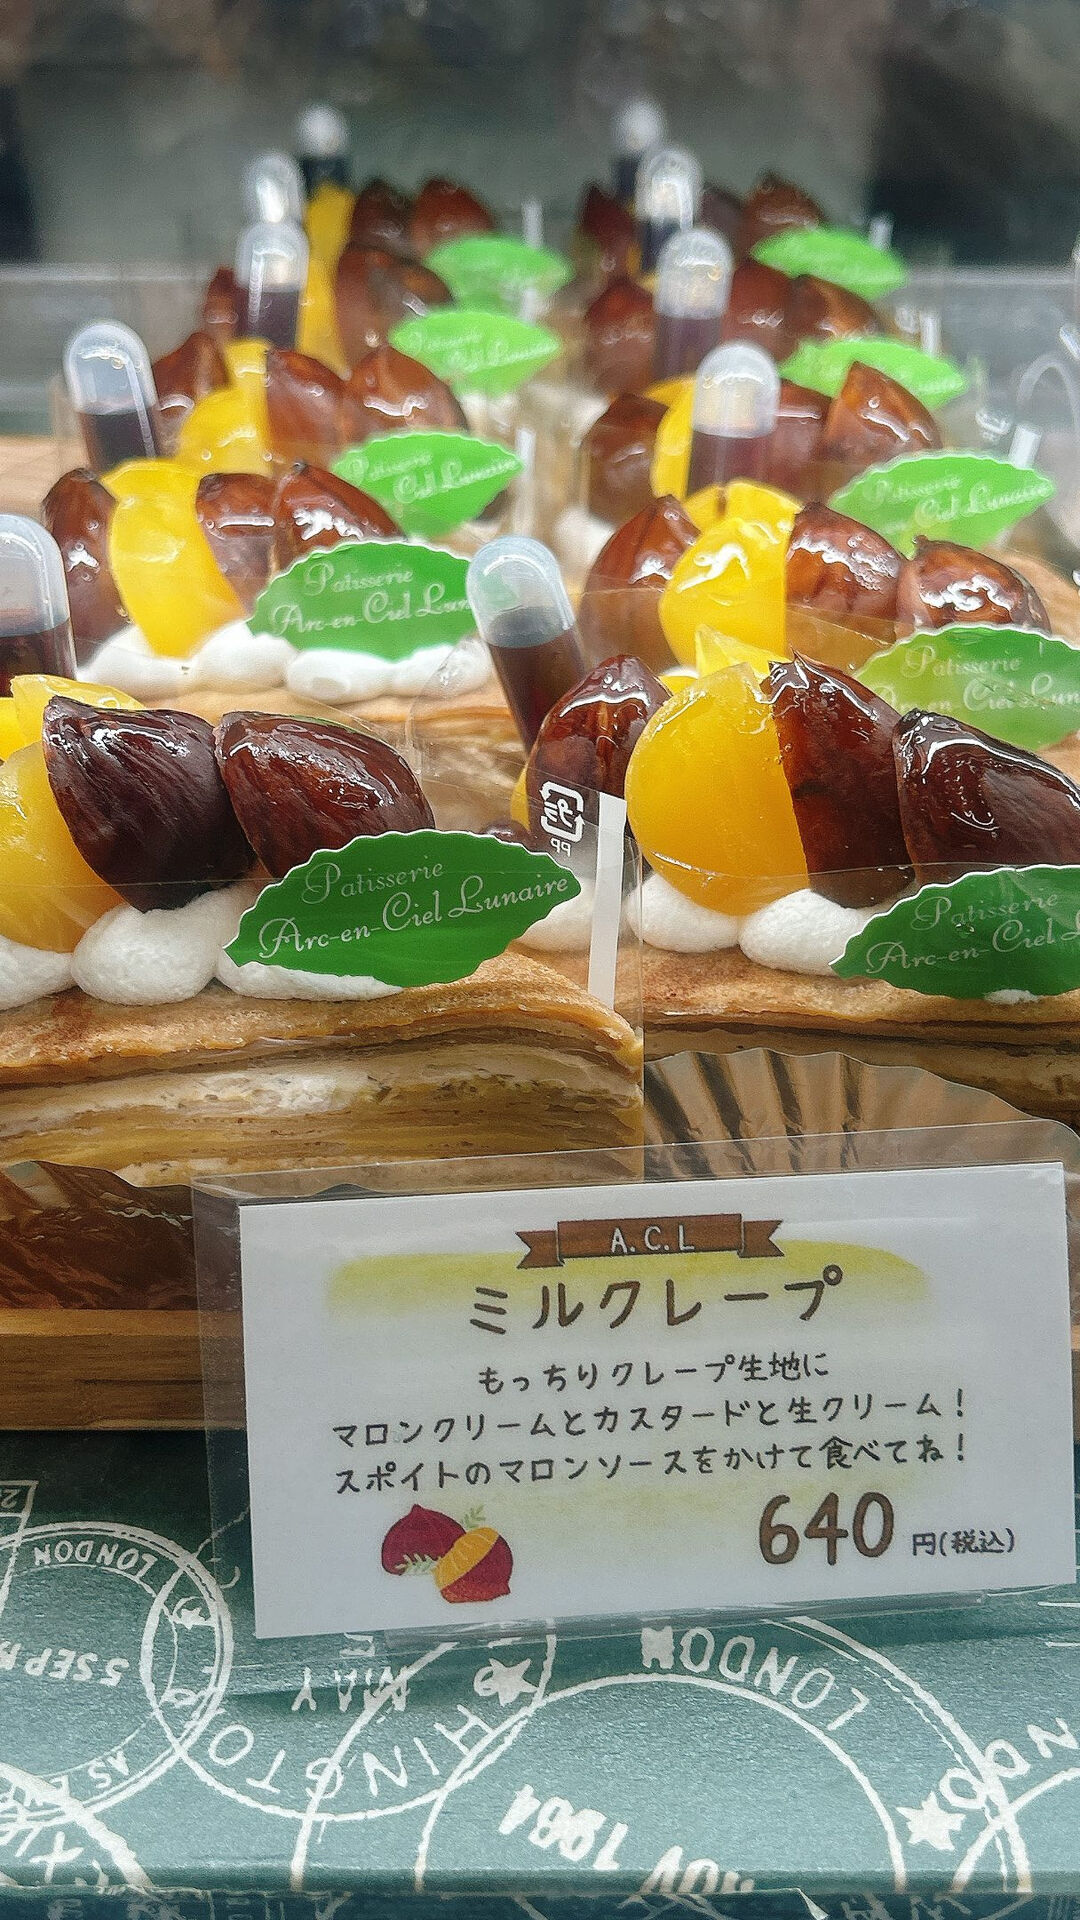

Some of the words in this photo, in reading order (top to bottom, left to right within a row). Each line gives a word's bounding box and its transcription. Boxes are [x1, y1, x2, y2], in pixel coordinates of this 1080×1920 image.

[301, 853, 444, 905] Patisserie
[259, 889, 443, 959] Arc-en-Ciel
[447, 873, 569, 919] Lunaire
[910, 888, 1058, 931] Patisserie
[866, 918, 1056, 975] Arc-en-Ciel
[611, 1224, 696, 1254] A.C.L
[469, 1264, 843, 1335] ミルクレープ
[479, 1351, 830, 1395] もっちりクレープ生地に
[333, 1388, 964, 1448] マロンクリームとカスタードと生クリーム！
[336, 1432, 965, 1494] スポイトのマロンソースをかけて食べてね！
[758, 1491, 894, 1566] 640
[33, 1540, 158, 1580] LONDON
